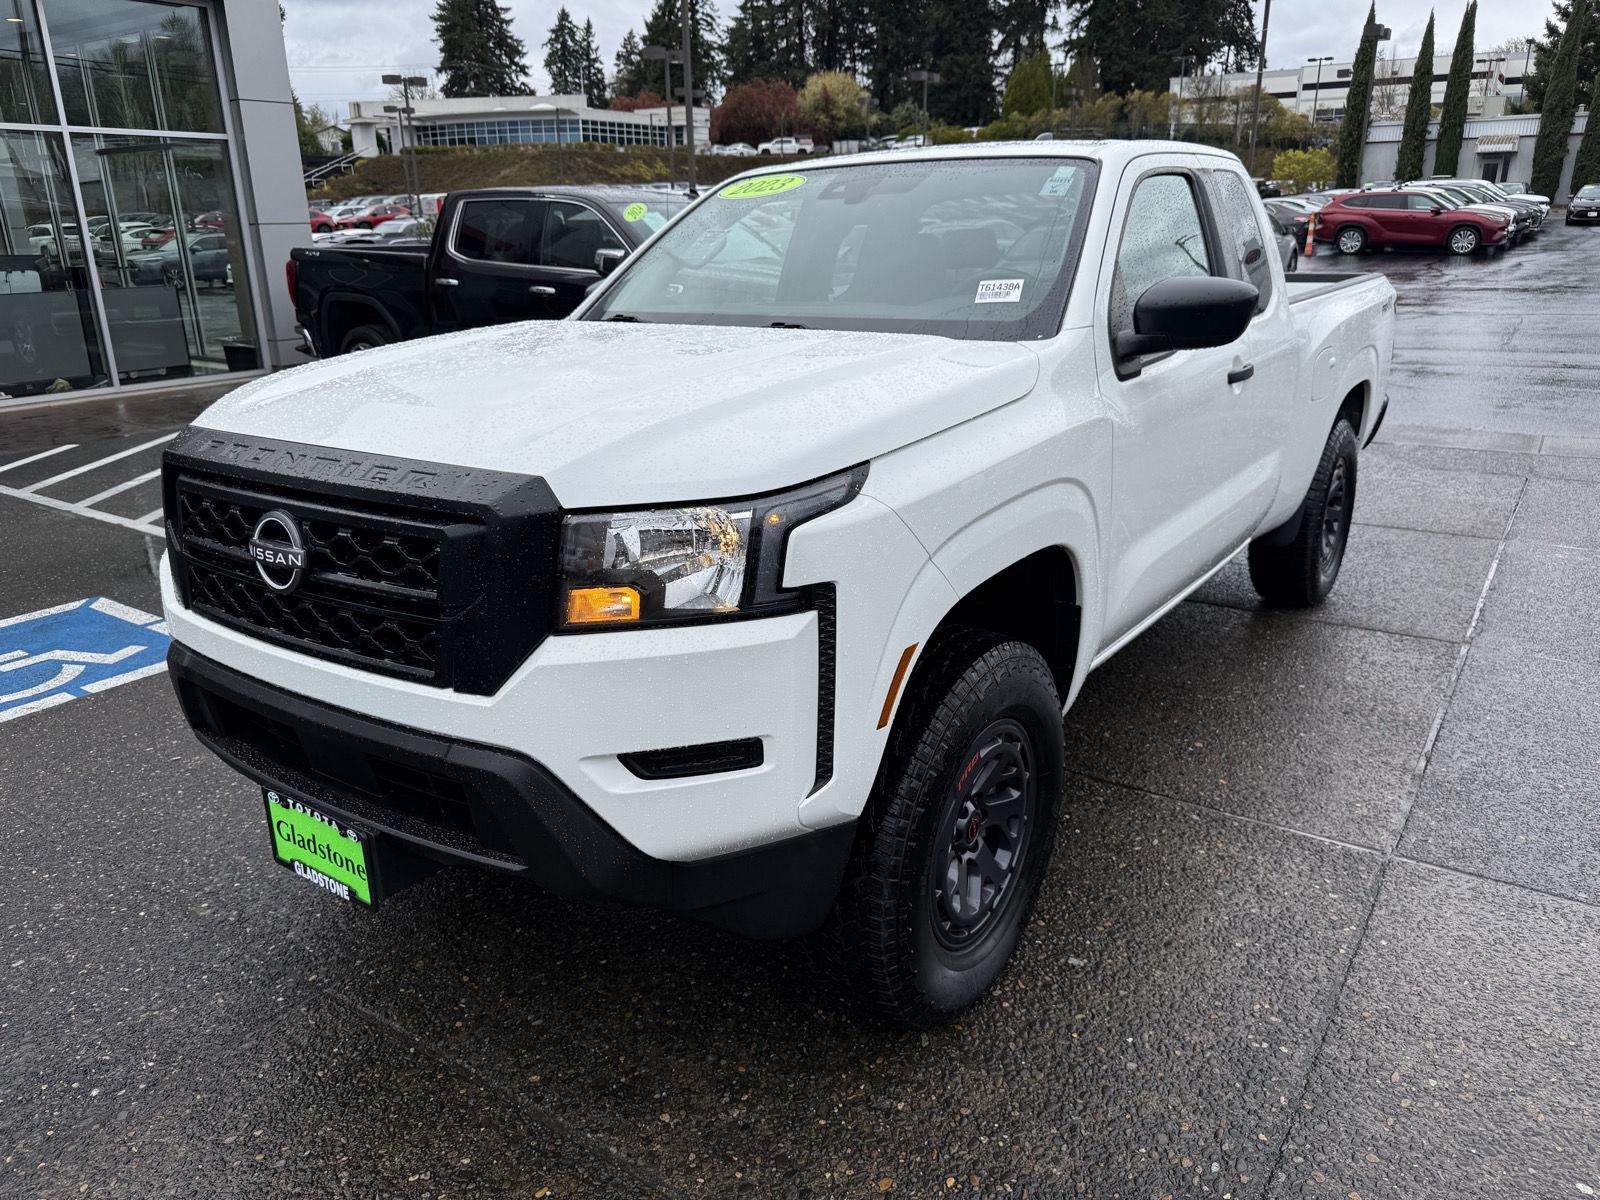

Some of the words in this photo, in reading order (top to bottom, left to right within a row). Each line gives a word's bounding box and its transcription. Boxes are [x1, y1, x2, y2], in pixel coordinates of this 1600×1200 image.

[726, 177, 797, 196] 2023
[980, 282, 1020, 292] T61438A
[199, 438, 439, 489] FRONTIER
[249, 541, 302, 566] NISSAN
[286, 798, 340, 832] TOYOTA
[277, 820, 367, 881] Gladstone
[294, 860, 351, 901] GLADSTONE
